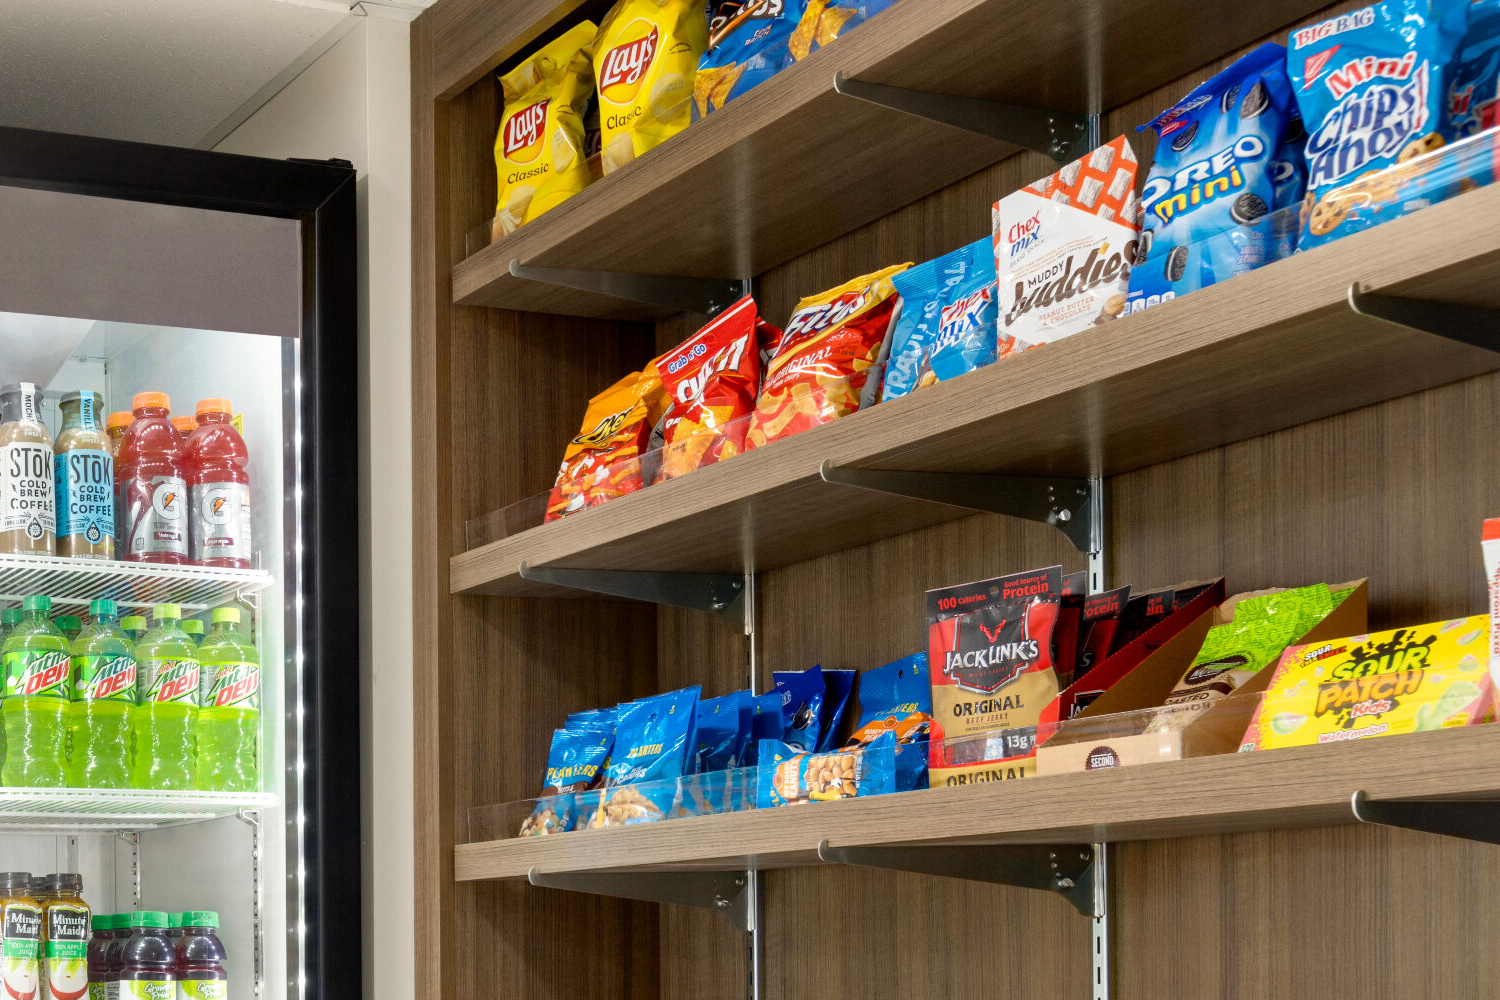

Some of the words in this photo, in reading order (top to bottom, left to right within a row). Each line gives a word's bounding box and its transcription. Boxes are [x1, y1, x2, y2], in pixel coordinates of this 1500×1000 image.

[1296, 21, 1333, 49] BIG
[1335, 7, 1376, 34] BAG
[602, 33, 657, 86] Lay's
[1326, 52, 1418, 99] Mini
[507, 105, 547, 152] Lay's
[606, 105, 642, 130] Classic
[1307, 78, 1426, 158] CHIPS
[506, 162, 549, 185] Classic
[1140, 136, 1264, 208] OREO
[1155, 166, 1243, 225] mini
[1008, 210, 1041, 245] Chex
[1010, 226, 1041, 257] mix
[1027, 259, 1065, 288] MUDDY
[19, 479, 47, 490] COLD
[70, 502, 113, 517] COFFEE
[79, 493, 107, 503] BREW
[937, 597, 957, 611] 100
[957, 592, 987, 605] Calories
[1002, 580, 1050, 601] Protein
[943, 649, 988, 676] JACK
[985, 639, 1040, 666] LINK'S
[1329, 645, 1431, 683] SOUR
[1316, 669, 1425, 718] PATCH
[953, 694, 1025, 717] ORIGINAL
[1350, 699, 1391, 719] Kids
[966, 715, 983, 725] BEEF
[985, 711, 1009, 723] JERKY
[1006, 733, 1028, 749] 13g
[1318, 722, 1389, 744] Watermelon
[1090, 753, 1115, 768] SECOND
[546, 763, 599, 782] PLANTERS
[53, 914, 86, 926] Minute
[56, 925, 83, 936] Maid
